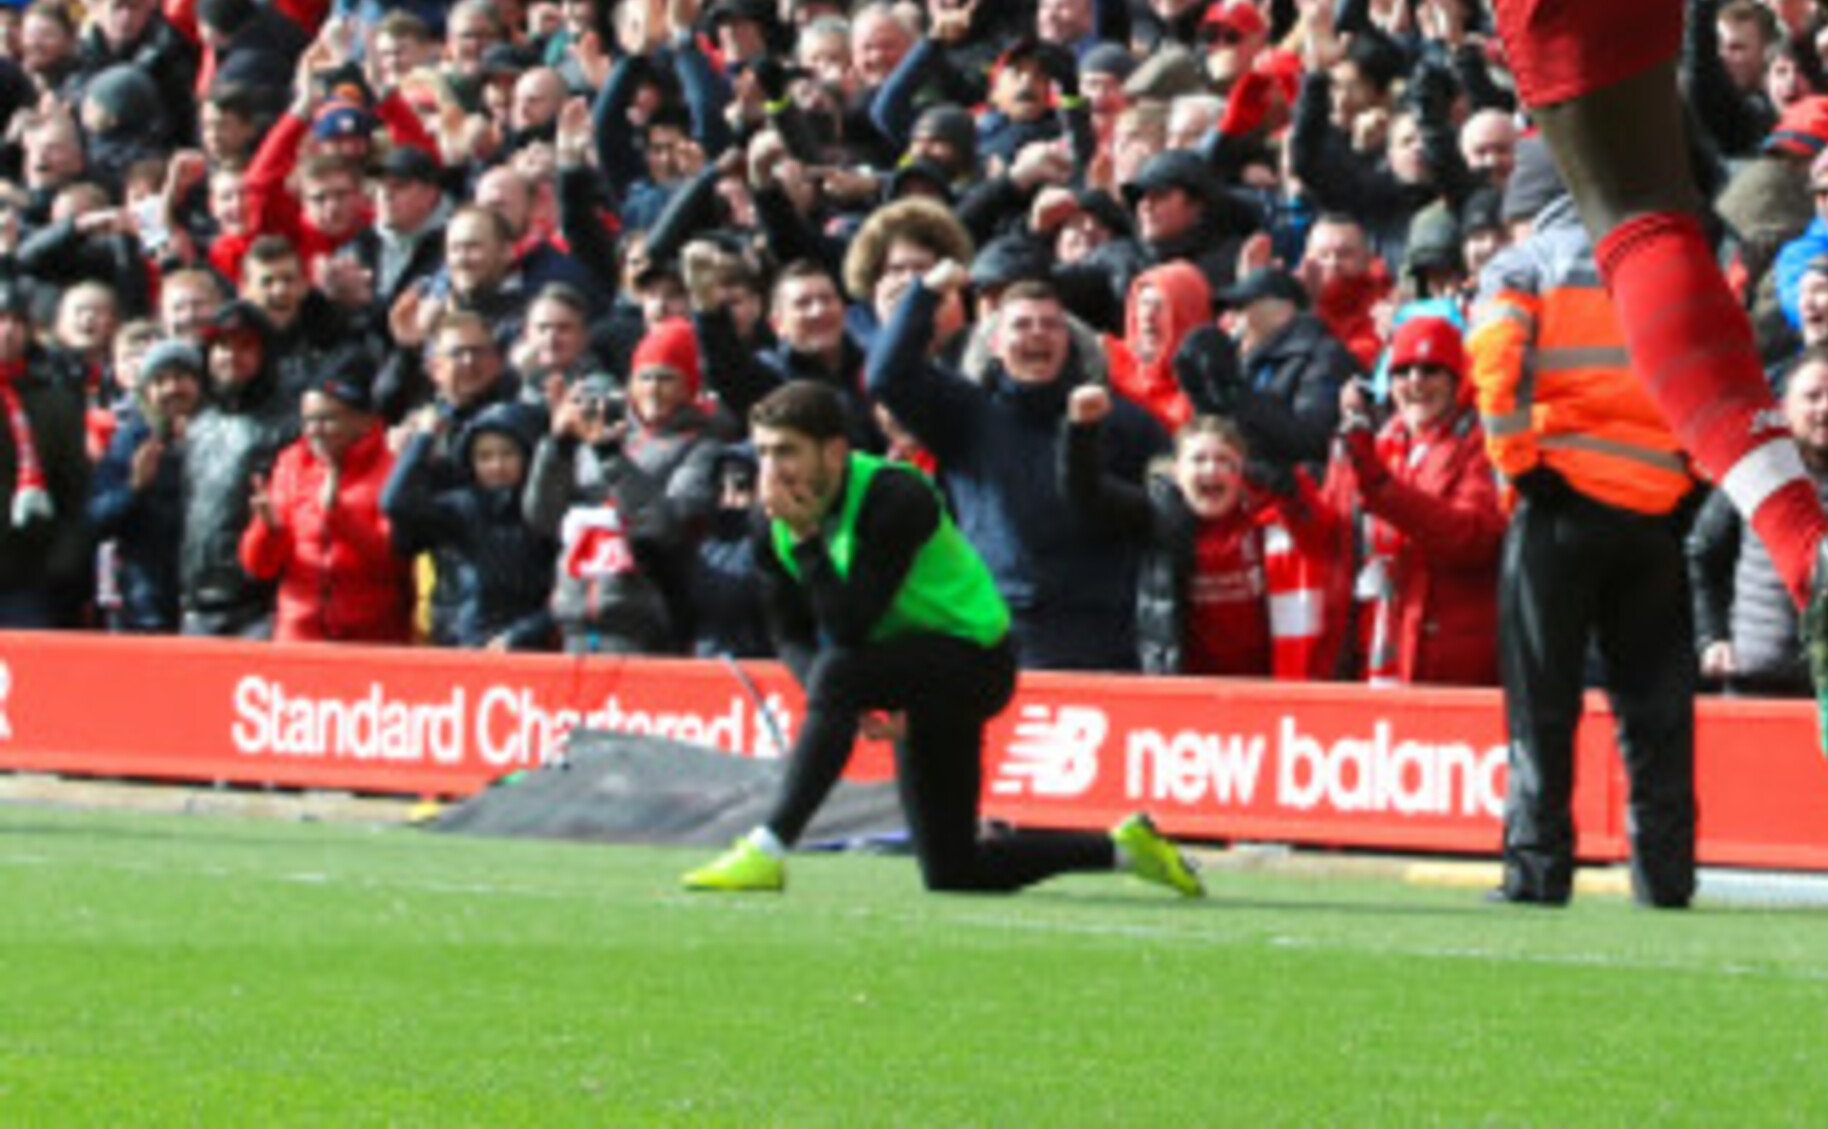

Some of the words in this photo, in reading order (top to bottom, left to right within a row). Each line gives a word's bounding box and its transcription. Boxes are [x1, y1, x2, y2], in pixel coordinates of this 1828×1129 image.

[231, 675, 466, 762] Standard
[1125, 726, 1265, 806] new
[1276, 714, 1510, 817] balanc
